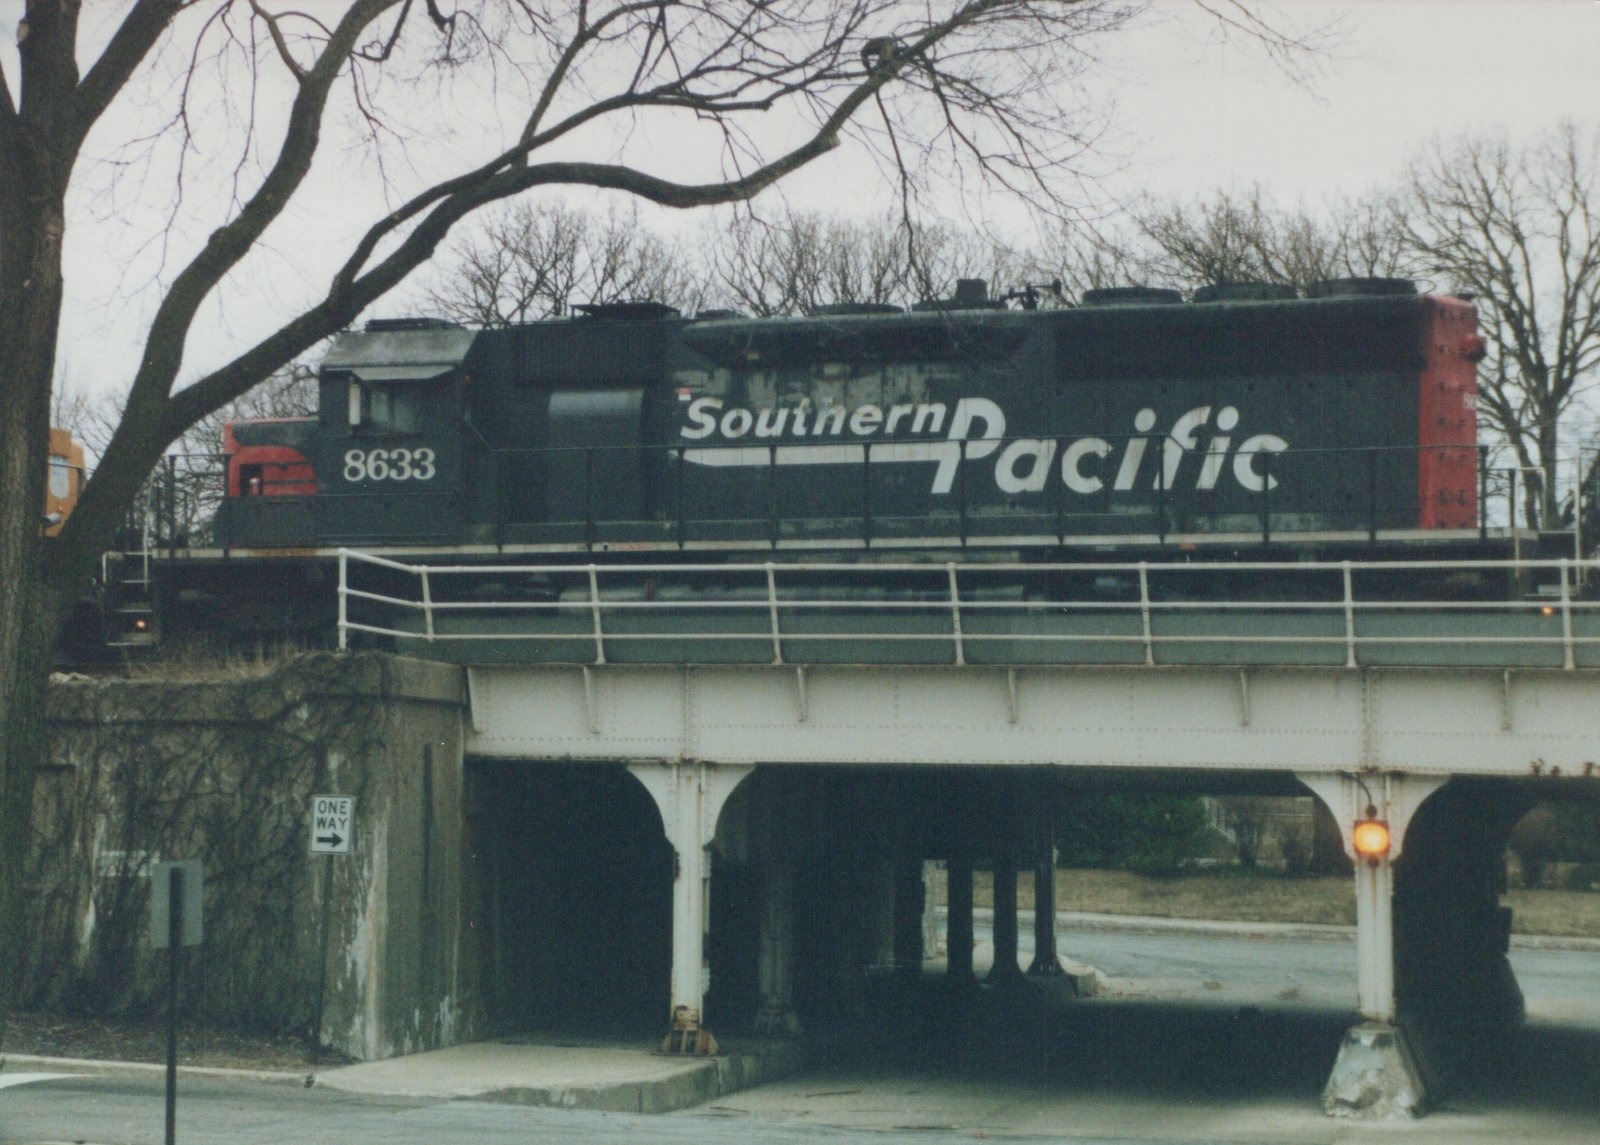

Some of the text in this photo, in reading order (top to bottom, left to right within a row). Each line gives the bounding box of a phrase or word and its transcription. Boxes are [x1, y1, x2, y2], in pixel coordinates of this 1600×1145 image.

[679, 396, 1290, 494] Southern Pacific
[343, 447, 436, 481] 8633
[318, 800, 348, 815] ONE
[316, 817, 348, 830] WAY
